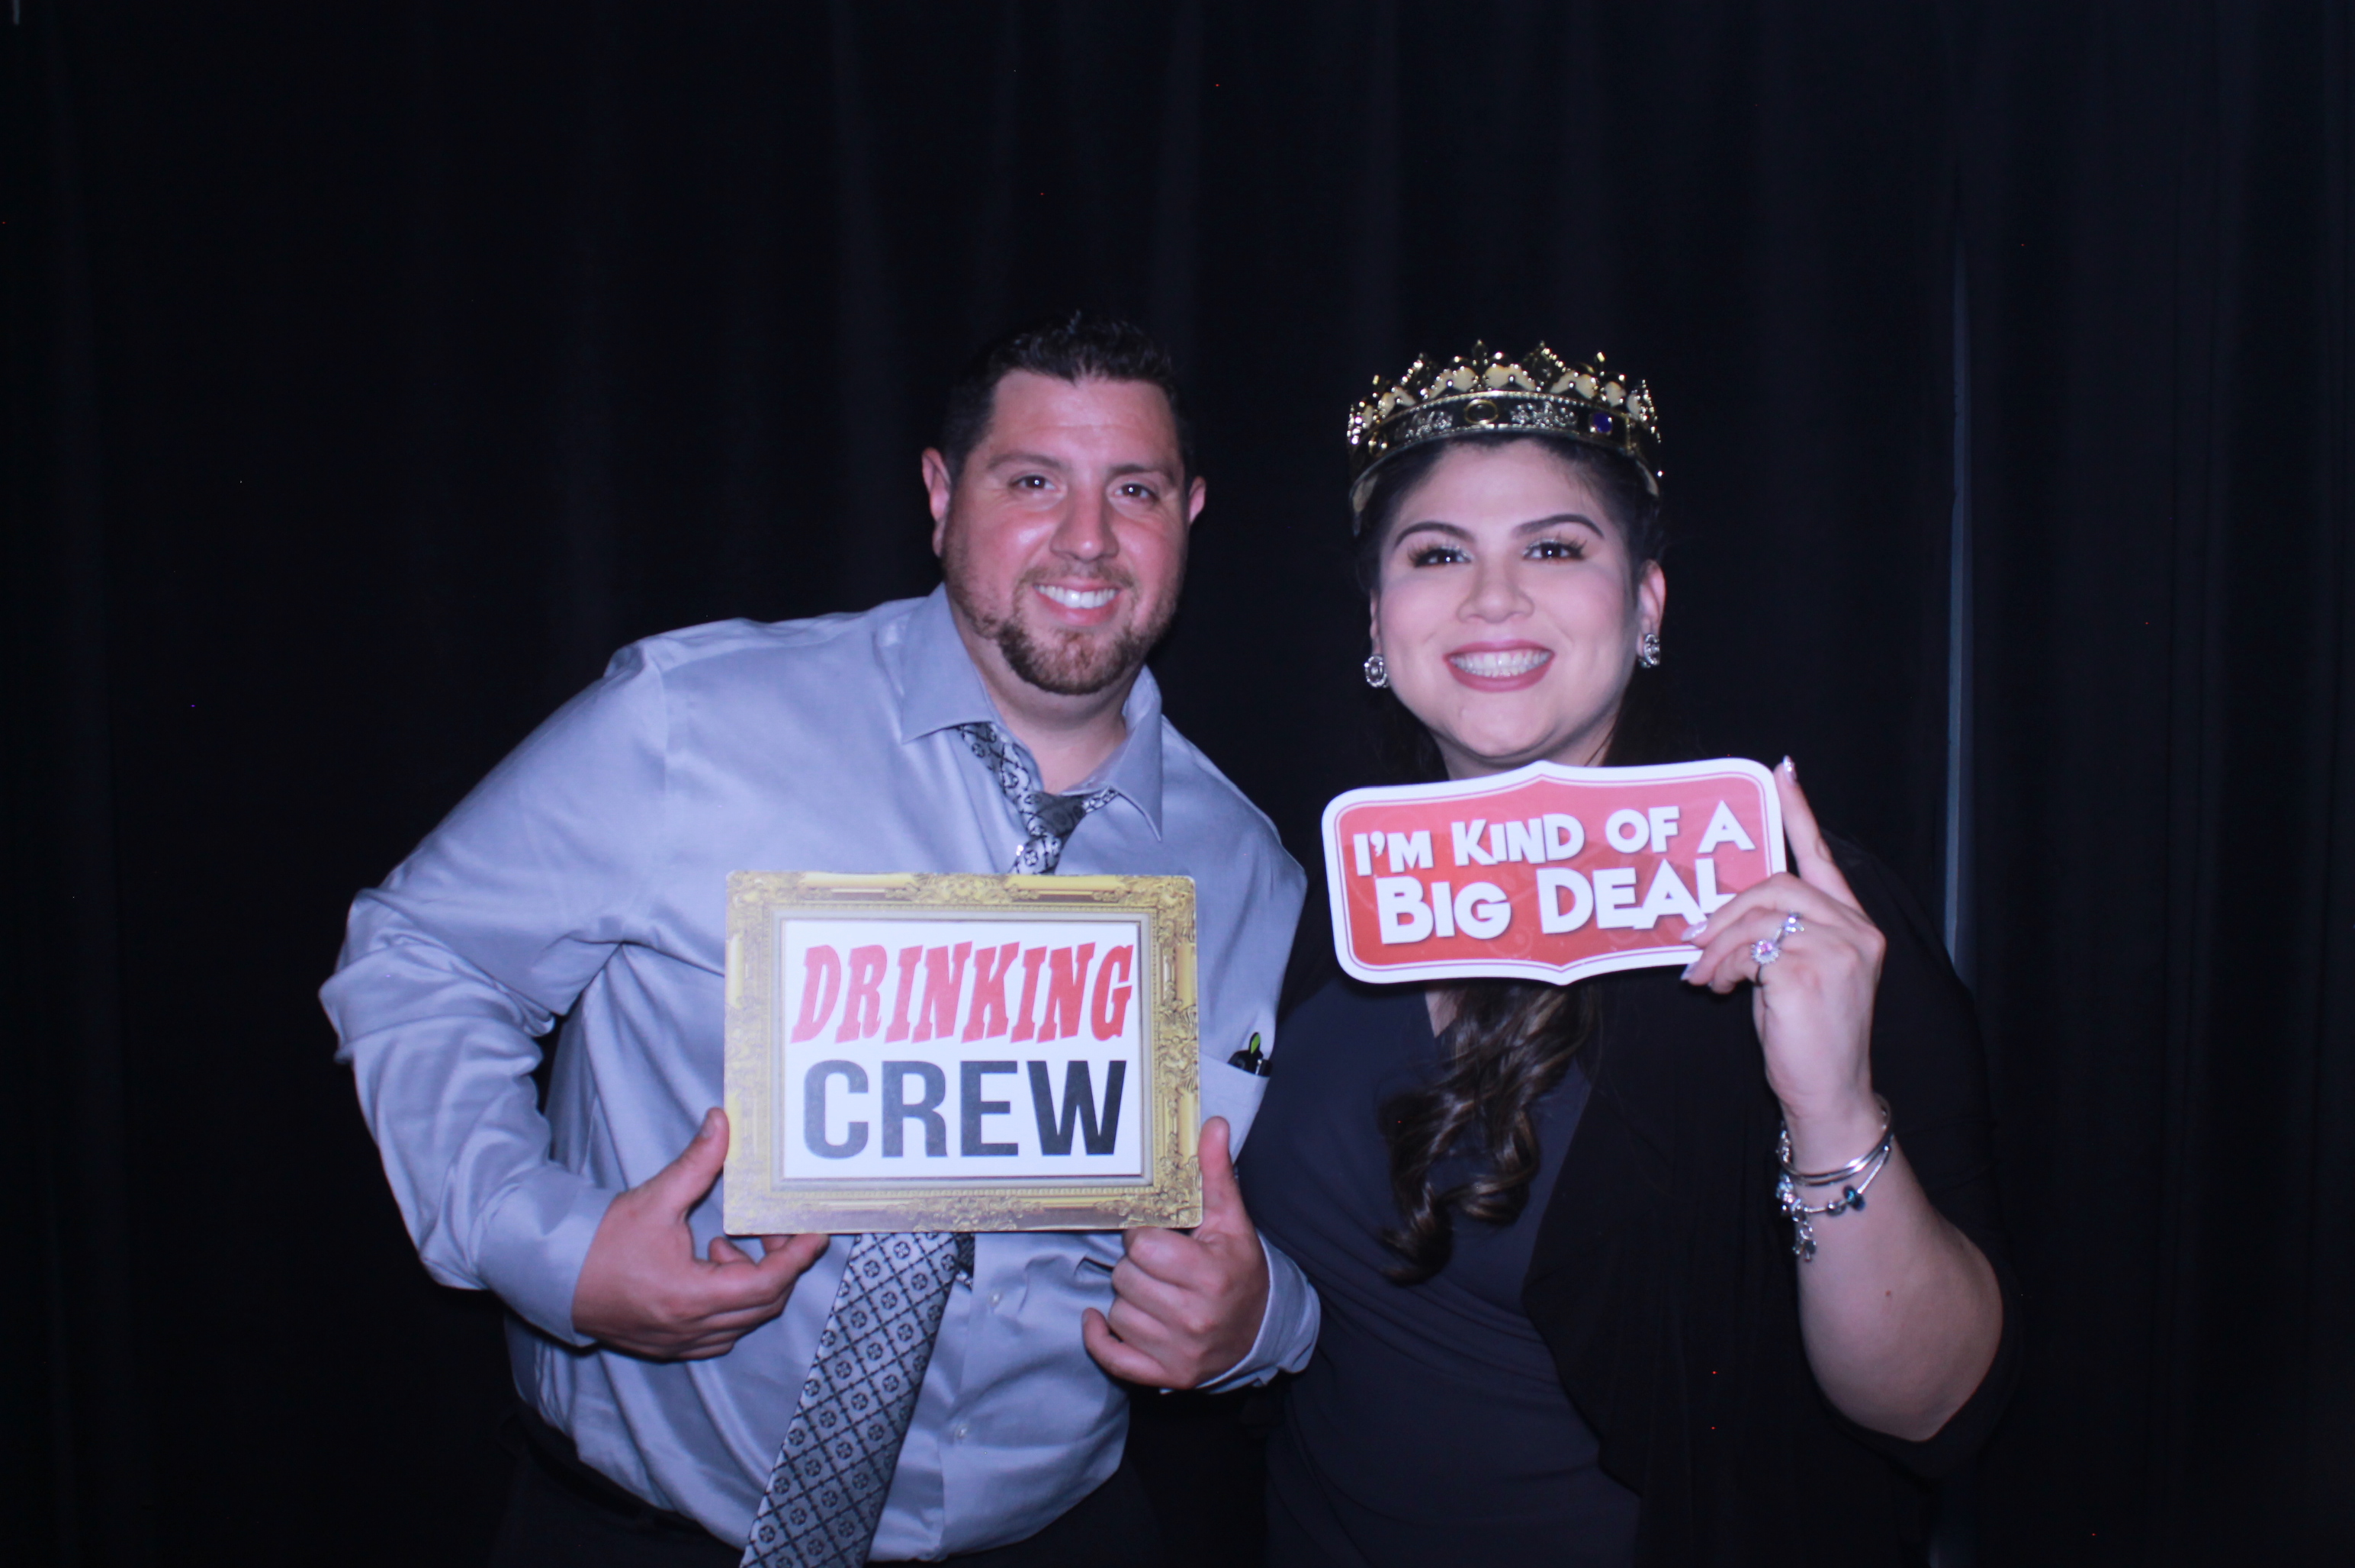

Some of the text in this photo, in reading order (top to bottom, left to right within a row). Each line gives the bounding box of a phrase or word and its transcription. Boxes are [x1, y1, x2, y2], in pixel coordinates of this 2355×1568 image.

[1354, 800, 1756, 876] I'M KIND OF A
[1376, 857, 1737, 945] BIG DEAL
[791, 941, 1134, 1043] DRINKING
[803, 1059, 1127, 1158] CREW
